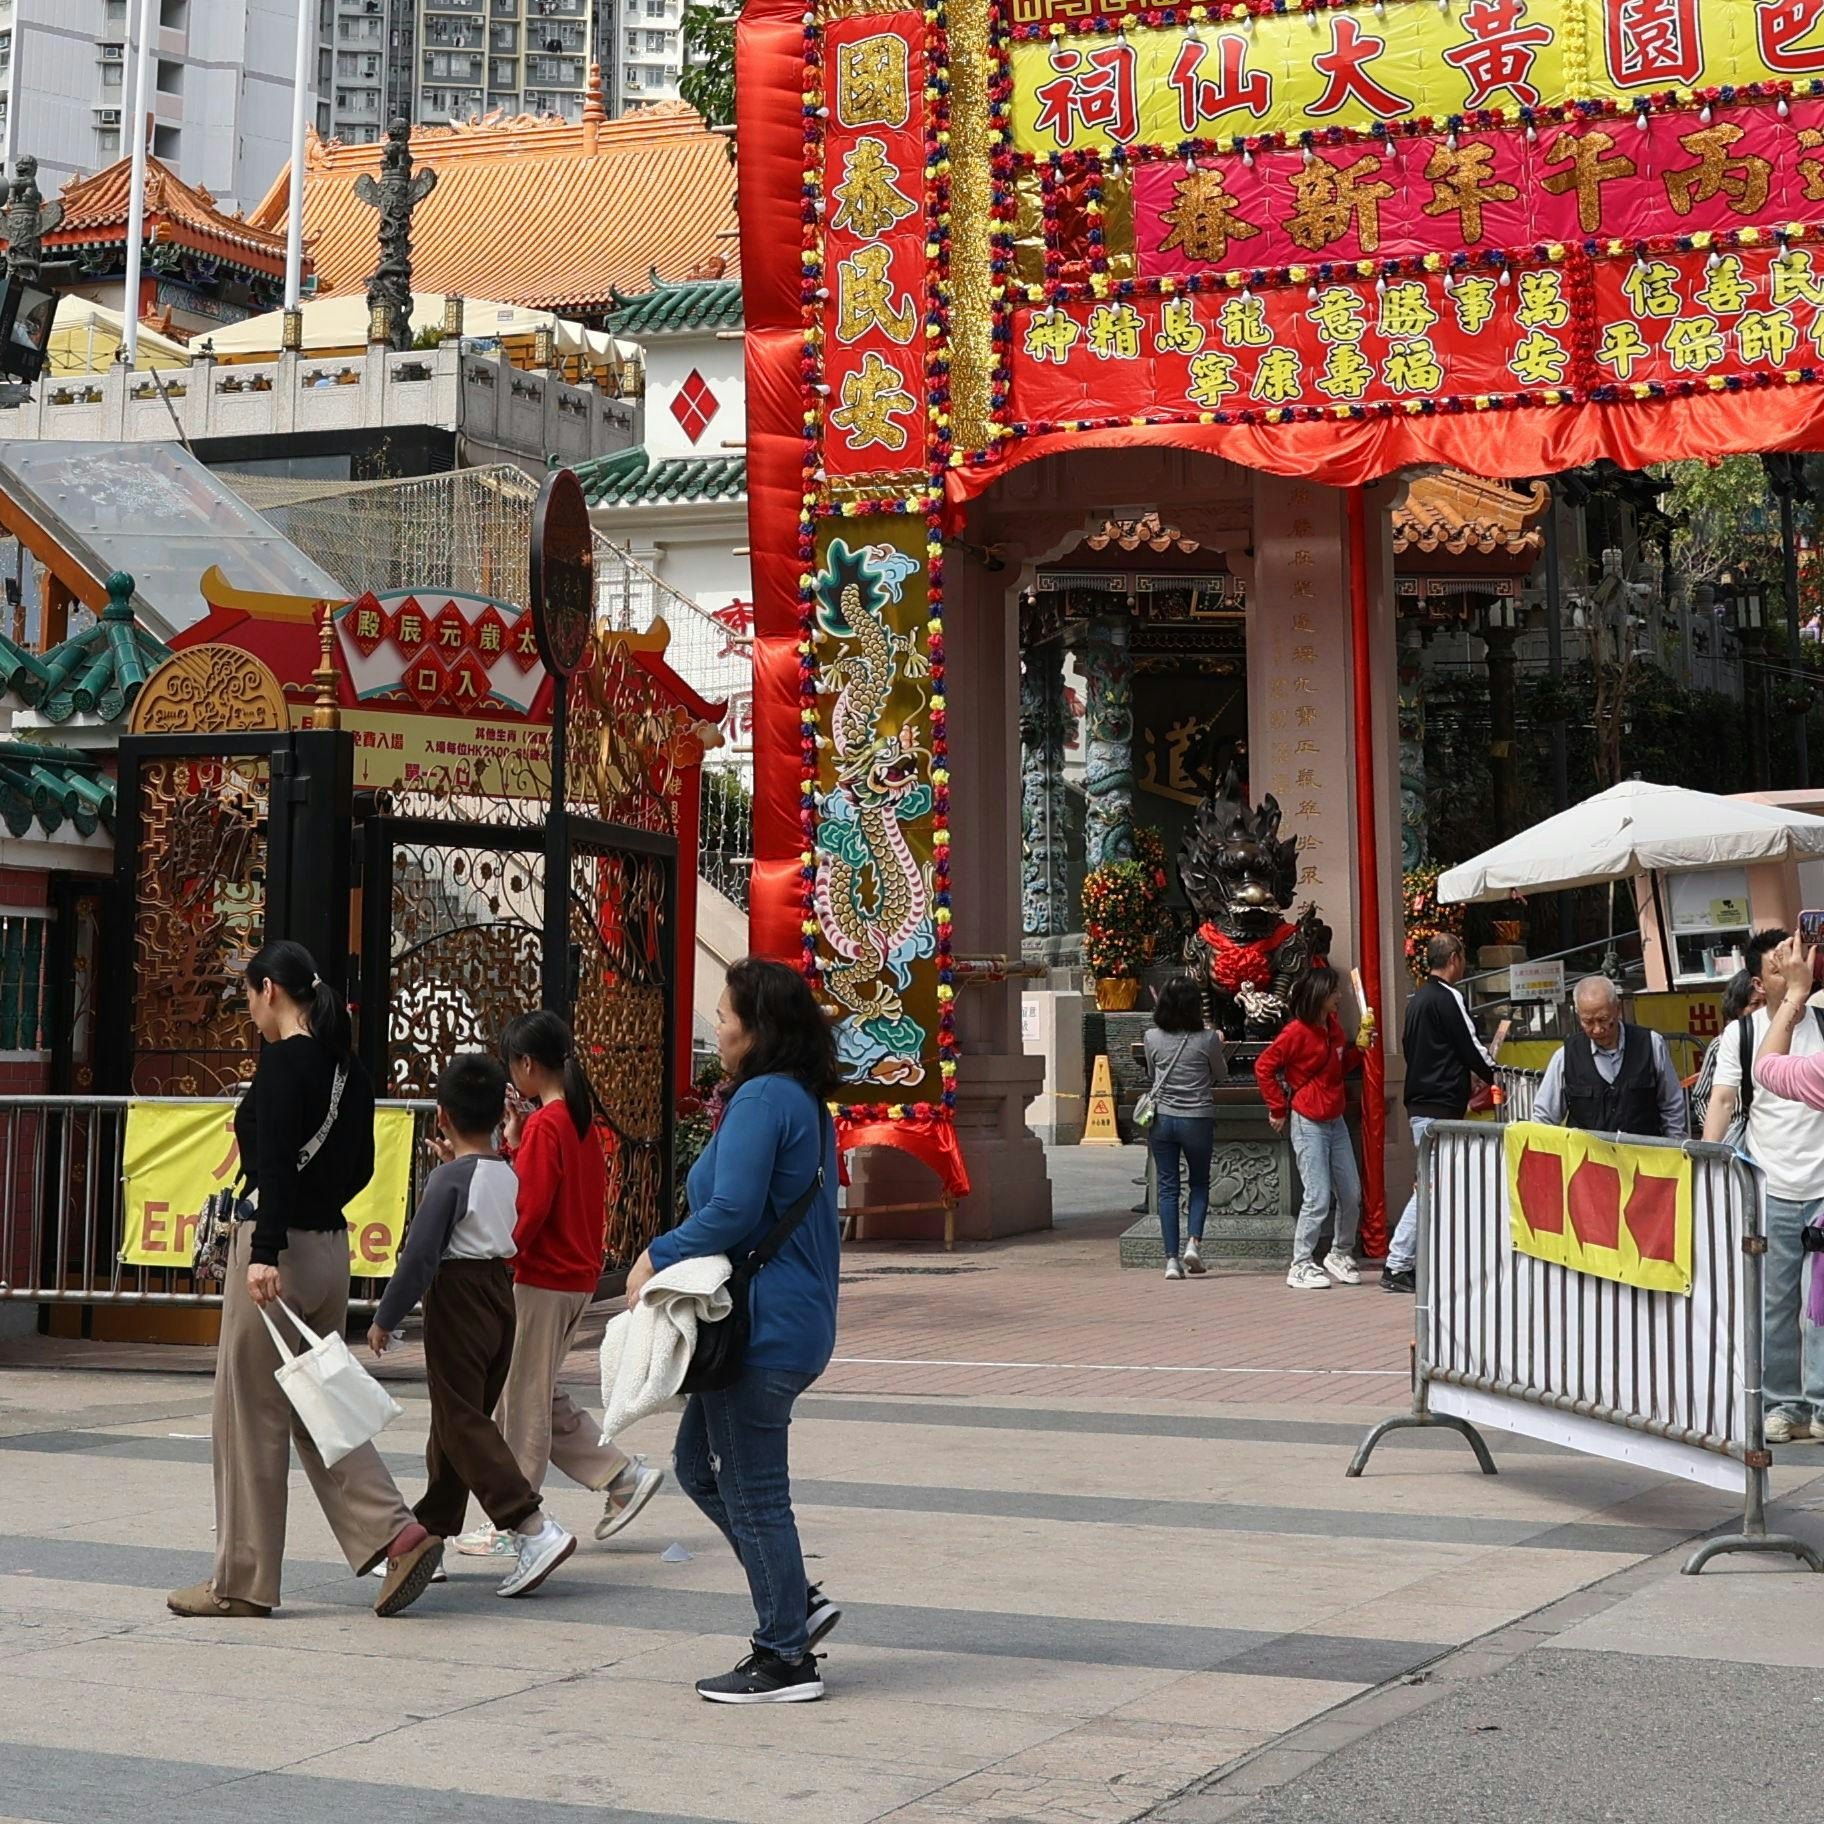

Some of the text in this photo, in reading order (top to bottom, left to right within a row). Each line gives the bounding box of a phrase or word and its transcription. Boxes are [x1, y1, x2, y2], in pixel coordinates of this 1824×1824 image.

[830, 33, 918, 450] 國泰民安
[1024, 294, 1275, 364] 龍馬精神
[1308, 270, 1570, 341] 萬事勝意
[1187, 338, 1445, 408] 福壽康寧
[356, 610, 538, 655] 太歲元辰殿
[418, 669, 477, 698] 入口
